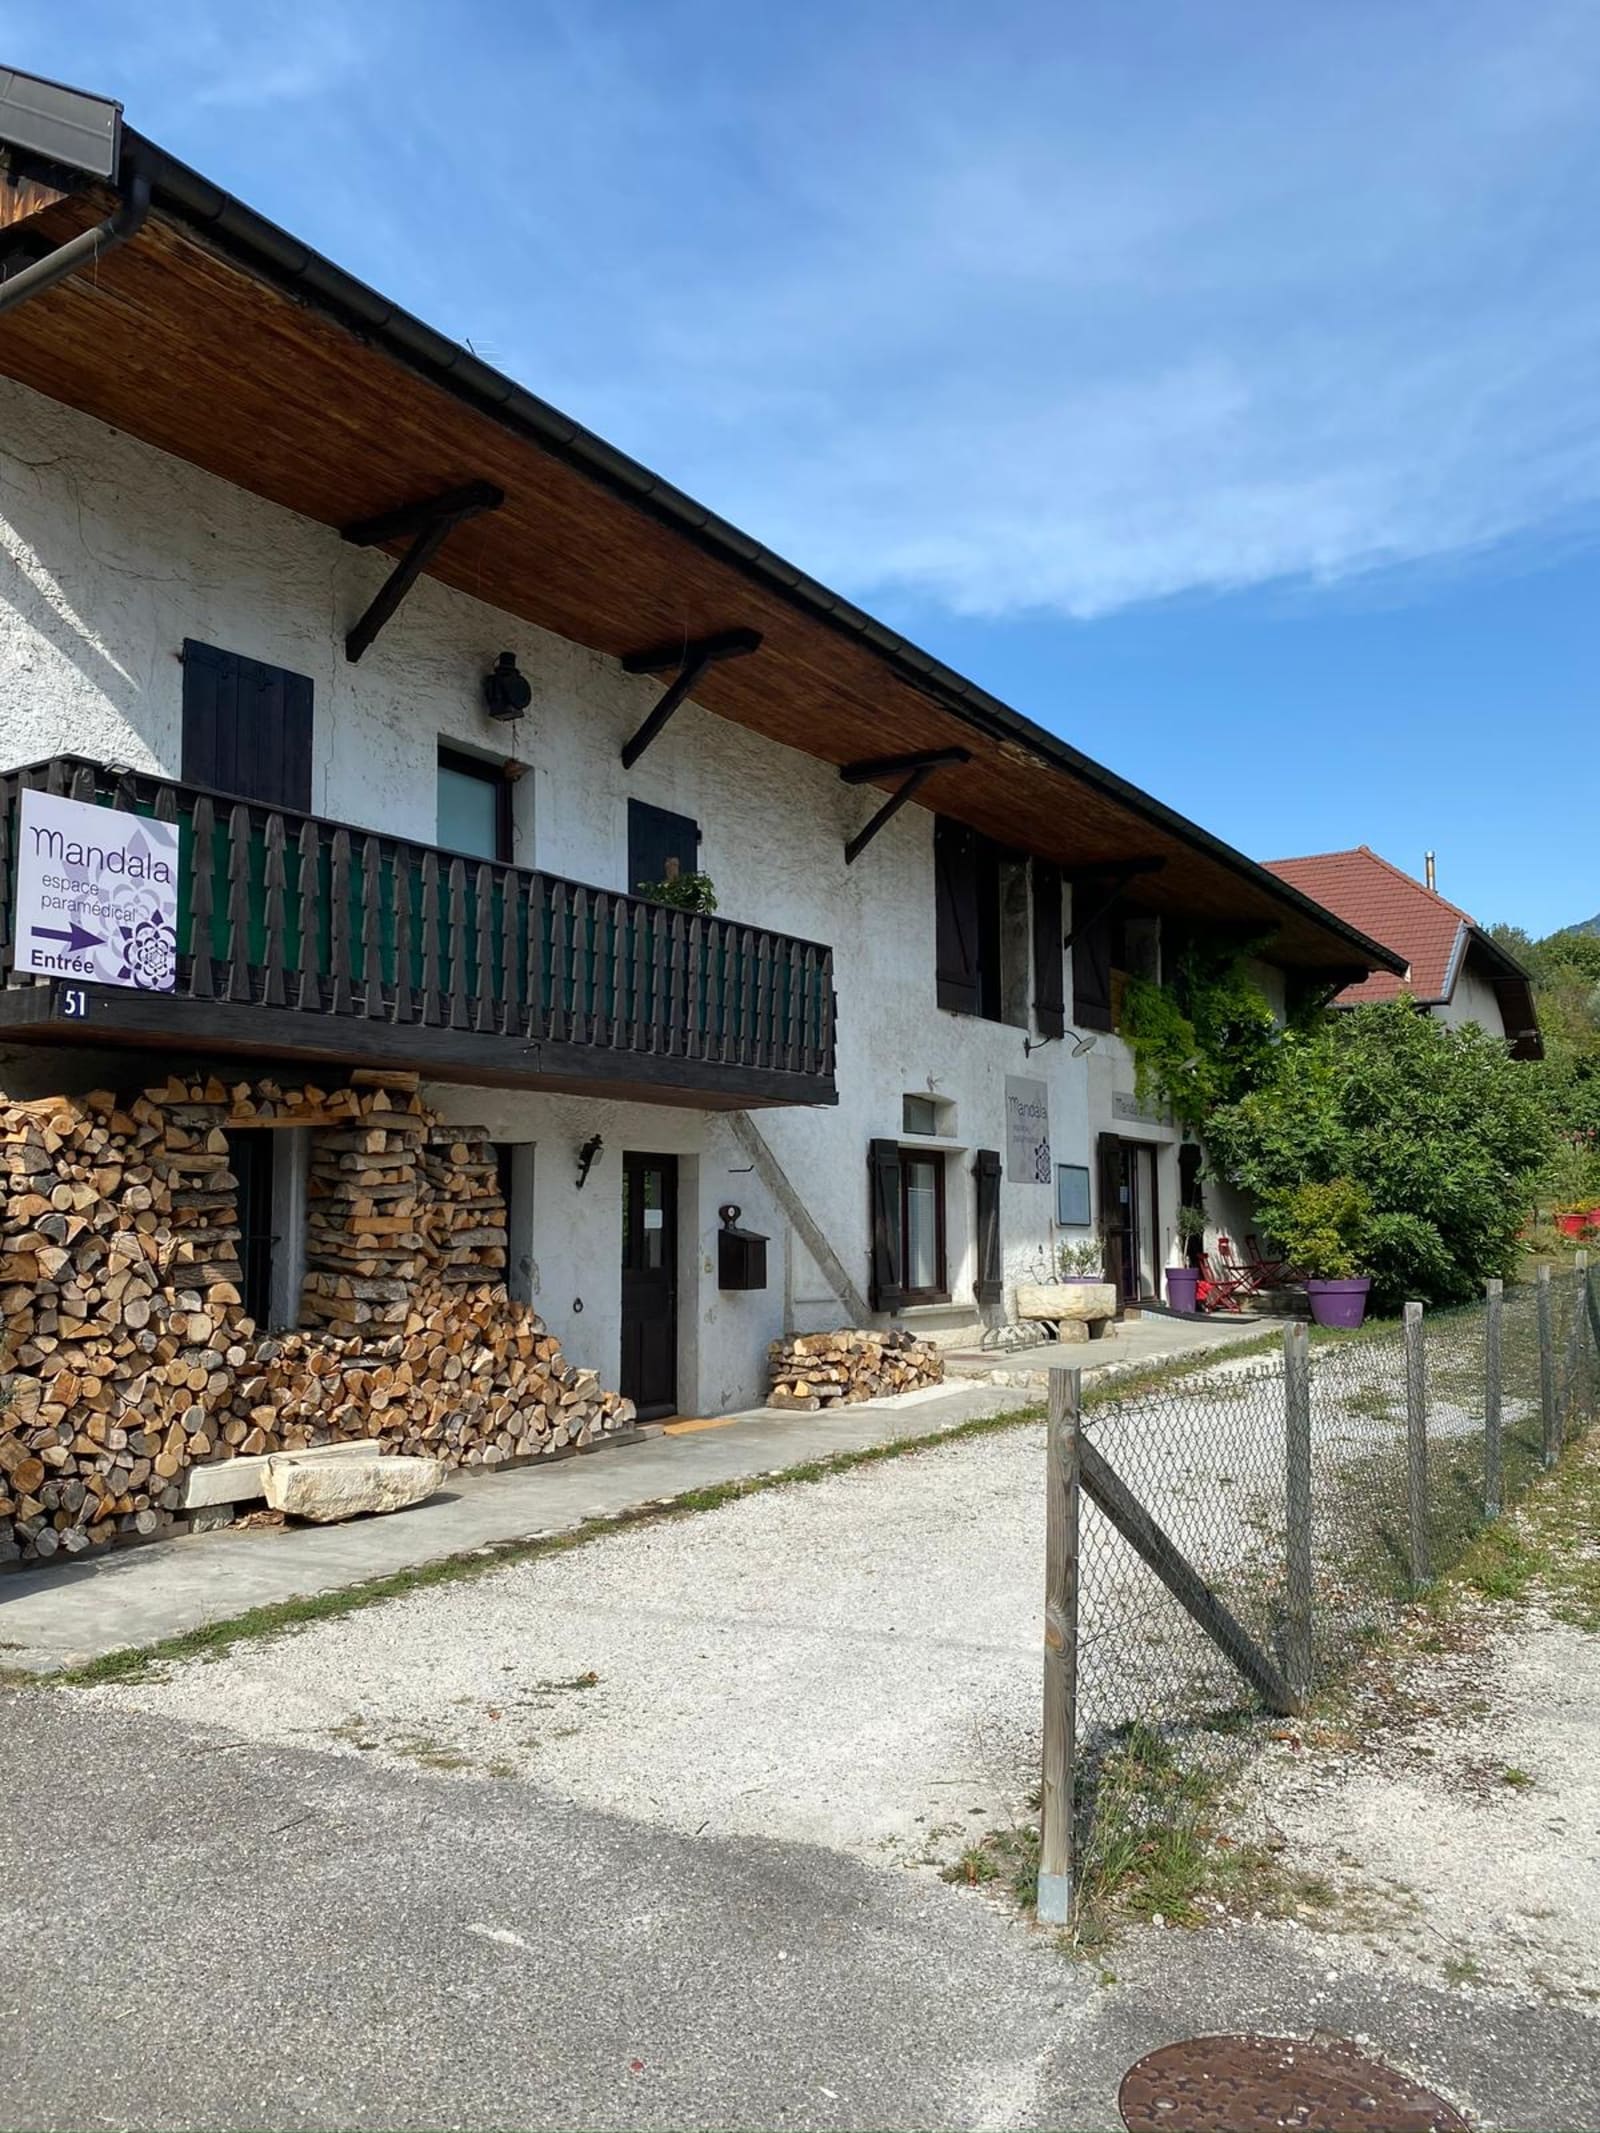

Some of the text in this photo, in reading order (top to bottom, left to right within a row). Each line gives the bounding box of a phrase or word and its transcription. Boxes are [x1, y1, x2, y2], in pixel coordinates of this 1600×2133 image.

[42, 874, 100, 895] espace
[41, 895, 136, 922] paramédical
[31, 949, 94, 974] Entrée
[64, 991, 85, 1016] 51
